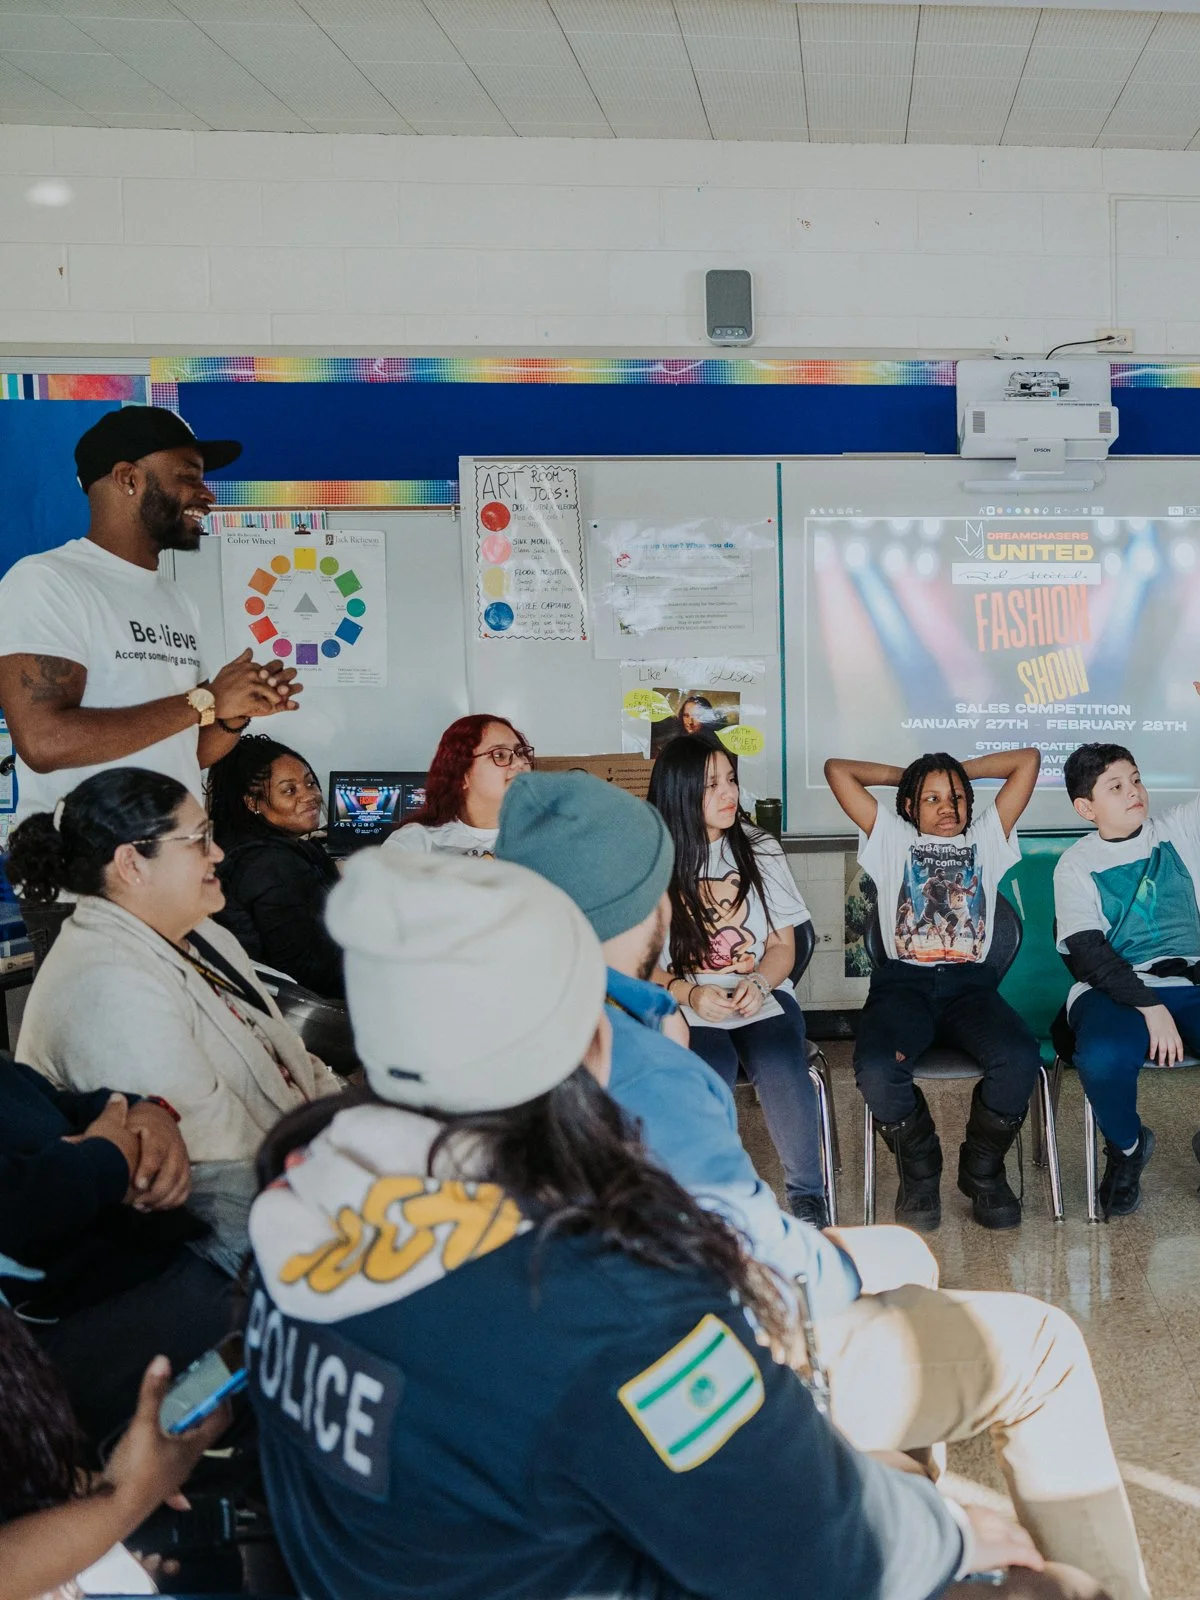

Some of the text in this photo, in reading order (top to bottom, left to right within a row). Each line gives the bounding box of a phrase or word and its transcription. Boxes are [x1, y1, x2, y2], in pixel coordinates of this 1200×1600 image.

[531, 470, 563, 482] ROOM
[483, 471, 524, 500] ART
[530, 486, 568, 502] JOS:
[227, 537, 276, 545] Color Wheel
[987, 532, 1089, 540] DREAMCHASERS
[987, 544, 1094, 561] UNITED
[974, 584, 1091, 652] FASHION
[115, 650, 148, 662] Accept
[180, 657, 187, 665] as
[1017, 645, 1089, 705] SHOW
[955, 703, 1131, 715] SALES COMPETITION
[901, 718, 980, 729] JANUARY
[986, 719, 1029, 729] 27TH
[1047, 720, 1137, 731] FEBRUARY
[1142, 721, 1187, 732] 28TH
[975, 741, 1019, 750] STORE
[942, 846, 967, 855] make
[935, 859, 962, 867] come
[243, 1290, 386, 1477] POLICE
